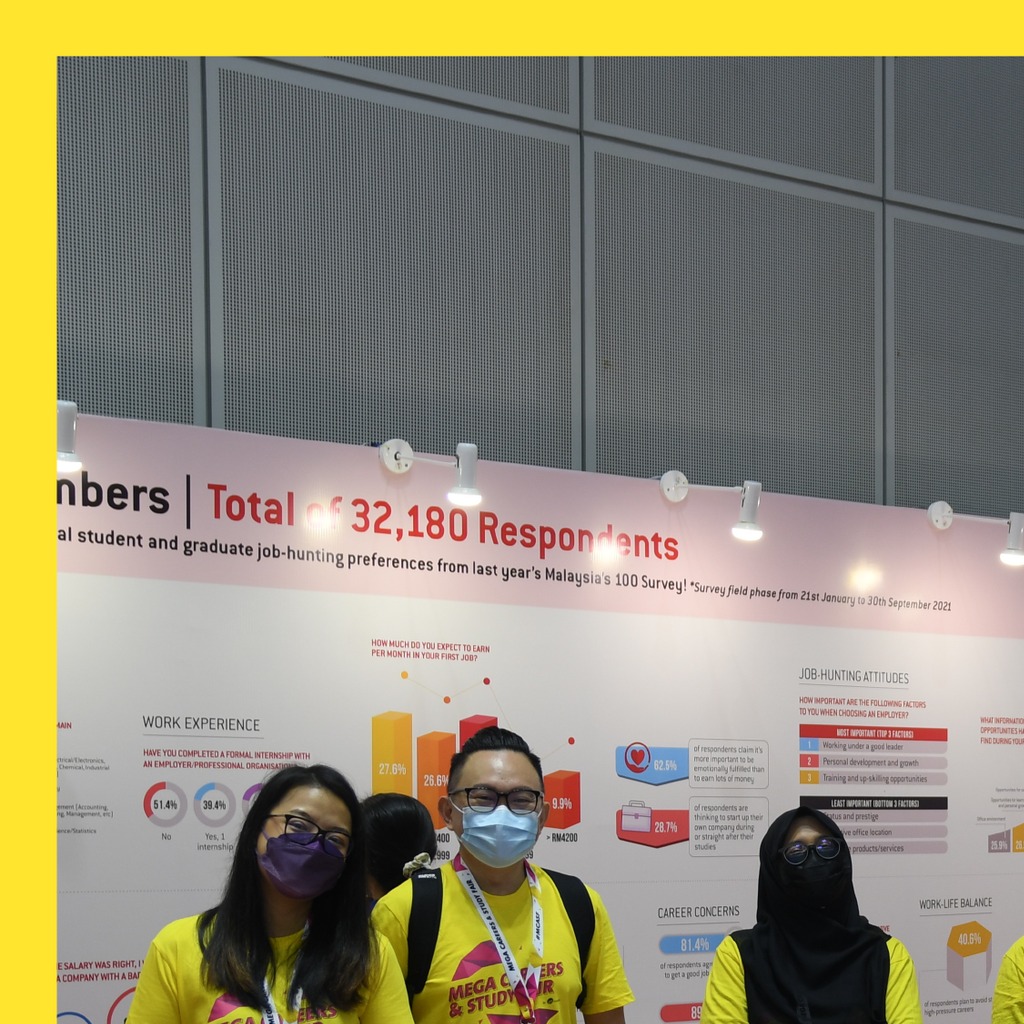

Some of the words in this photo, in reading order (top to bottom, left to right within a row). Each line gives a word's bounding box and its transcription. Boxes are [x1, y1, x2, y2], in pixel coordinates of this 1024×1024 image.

[207, 483, 295, 526] Total
[306, 496, 343, 529] of
[351, 498, 468, 542] 32,180
[479, 511, 679, 560] Respondents
[57, 526, 72, 541] al
[78, 529, 143, 548] student
[148, 535, 178, 550] and
[183, 539, 254, 556] graduate
[257, 543, 344, 568] job-hunting
[348, 552, 433, 571] preferences
[437, 558, 469, 574] from
[472, 561, 498, 577] last
[501, 565, 541, 581] year's
[545, 567, 611, 587] Malaysia's
[615, 572, 638, 588] 100
[641, 574, 687, 594] Survey!
[726, 584, 748, 597] field
[750, 587, 777, 600] phase
[777, 588, 799, 601] from
[800, 590, 820, 602] 21st
[821, 592, 856, 607] January
[857, 595, 865, 605] to
[867, 595, 887, 607] 30th
[888, 597, 931, 611] September
[932, 600, 952, 611] 2021
[371, 638, 388, 648] HOW
[389, 639, 410, 649] MUCH
[411, 641, 420, 649] DO
[422, 641, 436, 650] YOU
[437, 642, 461, 651] EXPECT
[463, 644, 472, 652] TO
[473, 644, 490, 653] EARN
[371, 649, 385, 657] PER
[387, 649, 411, 659] MONTH
[412, 651, 420, 659] IN
[422, 651, 439, 660] YOUR
[441, 652, 459, 661] FIRST
[461, 653, 477, 662] JOB?
[799, 667, 861, 682] JOB-HUNTING
[863, 670, 910, 684] ATTITUDES
[143, 715, 181, 729] WORK
[185, 717, 260, 731] EXPERIENCE
[143, 749, 159, 757] HAVE
[162, 749, 177, 758] YOU
[178, 750, 219, 758] COMPLETED
[226, 751, 253, 759] FORMAL
[255, 751, 294, 759] INTERNSHIP
[294, 752, 310, 760] WITH
[143, 760, 153, 768] AN
[154, 761, 244, 769] EMPLOYER/PROFESSIONAL
[379, 763, 406, 775] 27.6%
[654, 760, 677, 771] 62.5%
[823, 757, 849, 766] Personal
[849, 758, 886, 768] development
[887, 759, 899, 767] and
[899, 759, 919, 769] growth
[154, 800, 177, 810] 51.4%
[203, 800, 226, 810] 39.4%
[552, 797, 572, 810] 9.9%
[655, 822, 678, 833] 28.7%
[161, 833, 172, 841] No
[205, 833, 219, 842] Yes,
[222, 833, 225, 841] 1
[551, 833, 578, 843] RM4200
[197, 842, 234, 852] internship
[466, 879, 477, 894] FAIR
[474, 894, 489, 914] STUDY
[919, 899, 958, 910] WORK-LIFE
[960, 898, 992, 908] BALANCE
[658, 907, 692, 919] CAREER
[694, 905, 740, 918] CONCERNS
[489, 921, 506, 949] CAREERS
[958, 933, 981, 945] 40.6%
[681, 938, 709, 952] 81.4%
[502, 951, 515, 972] MEGA
[449, 976, 496, 1002] MEGA
[448, 1002, 463, 1018] &
[467, 992, 515, 1014] STUDY
